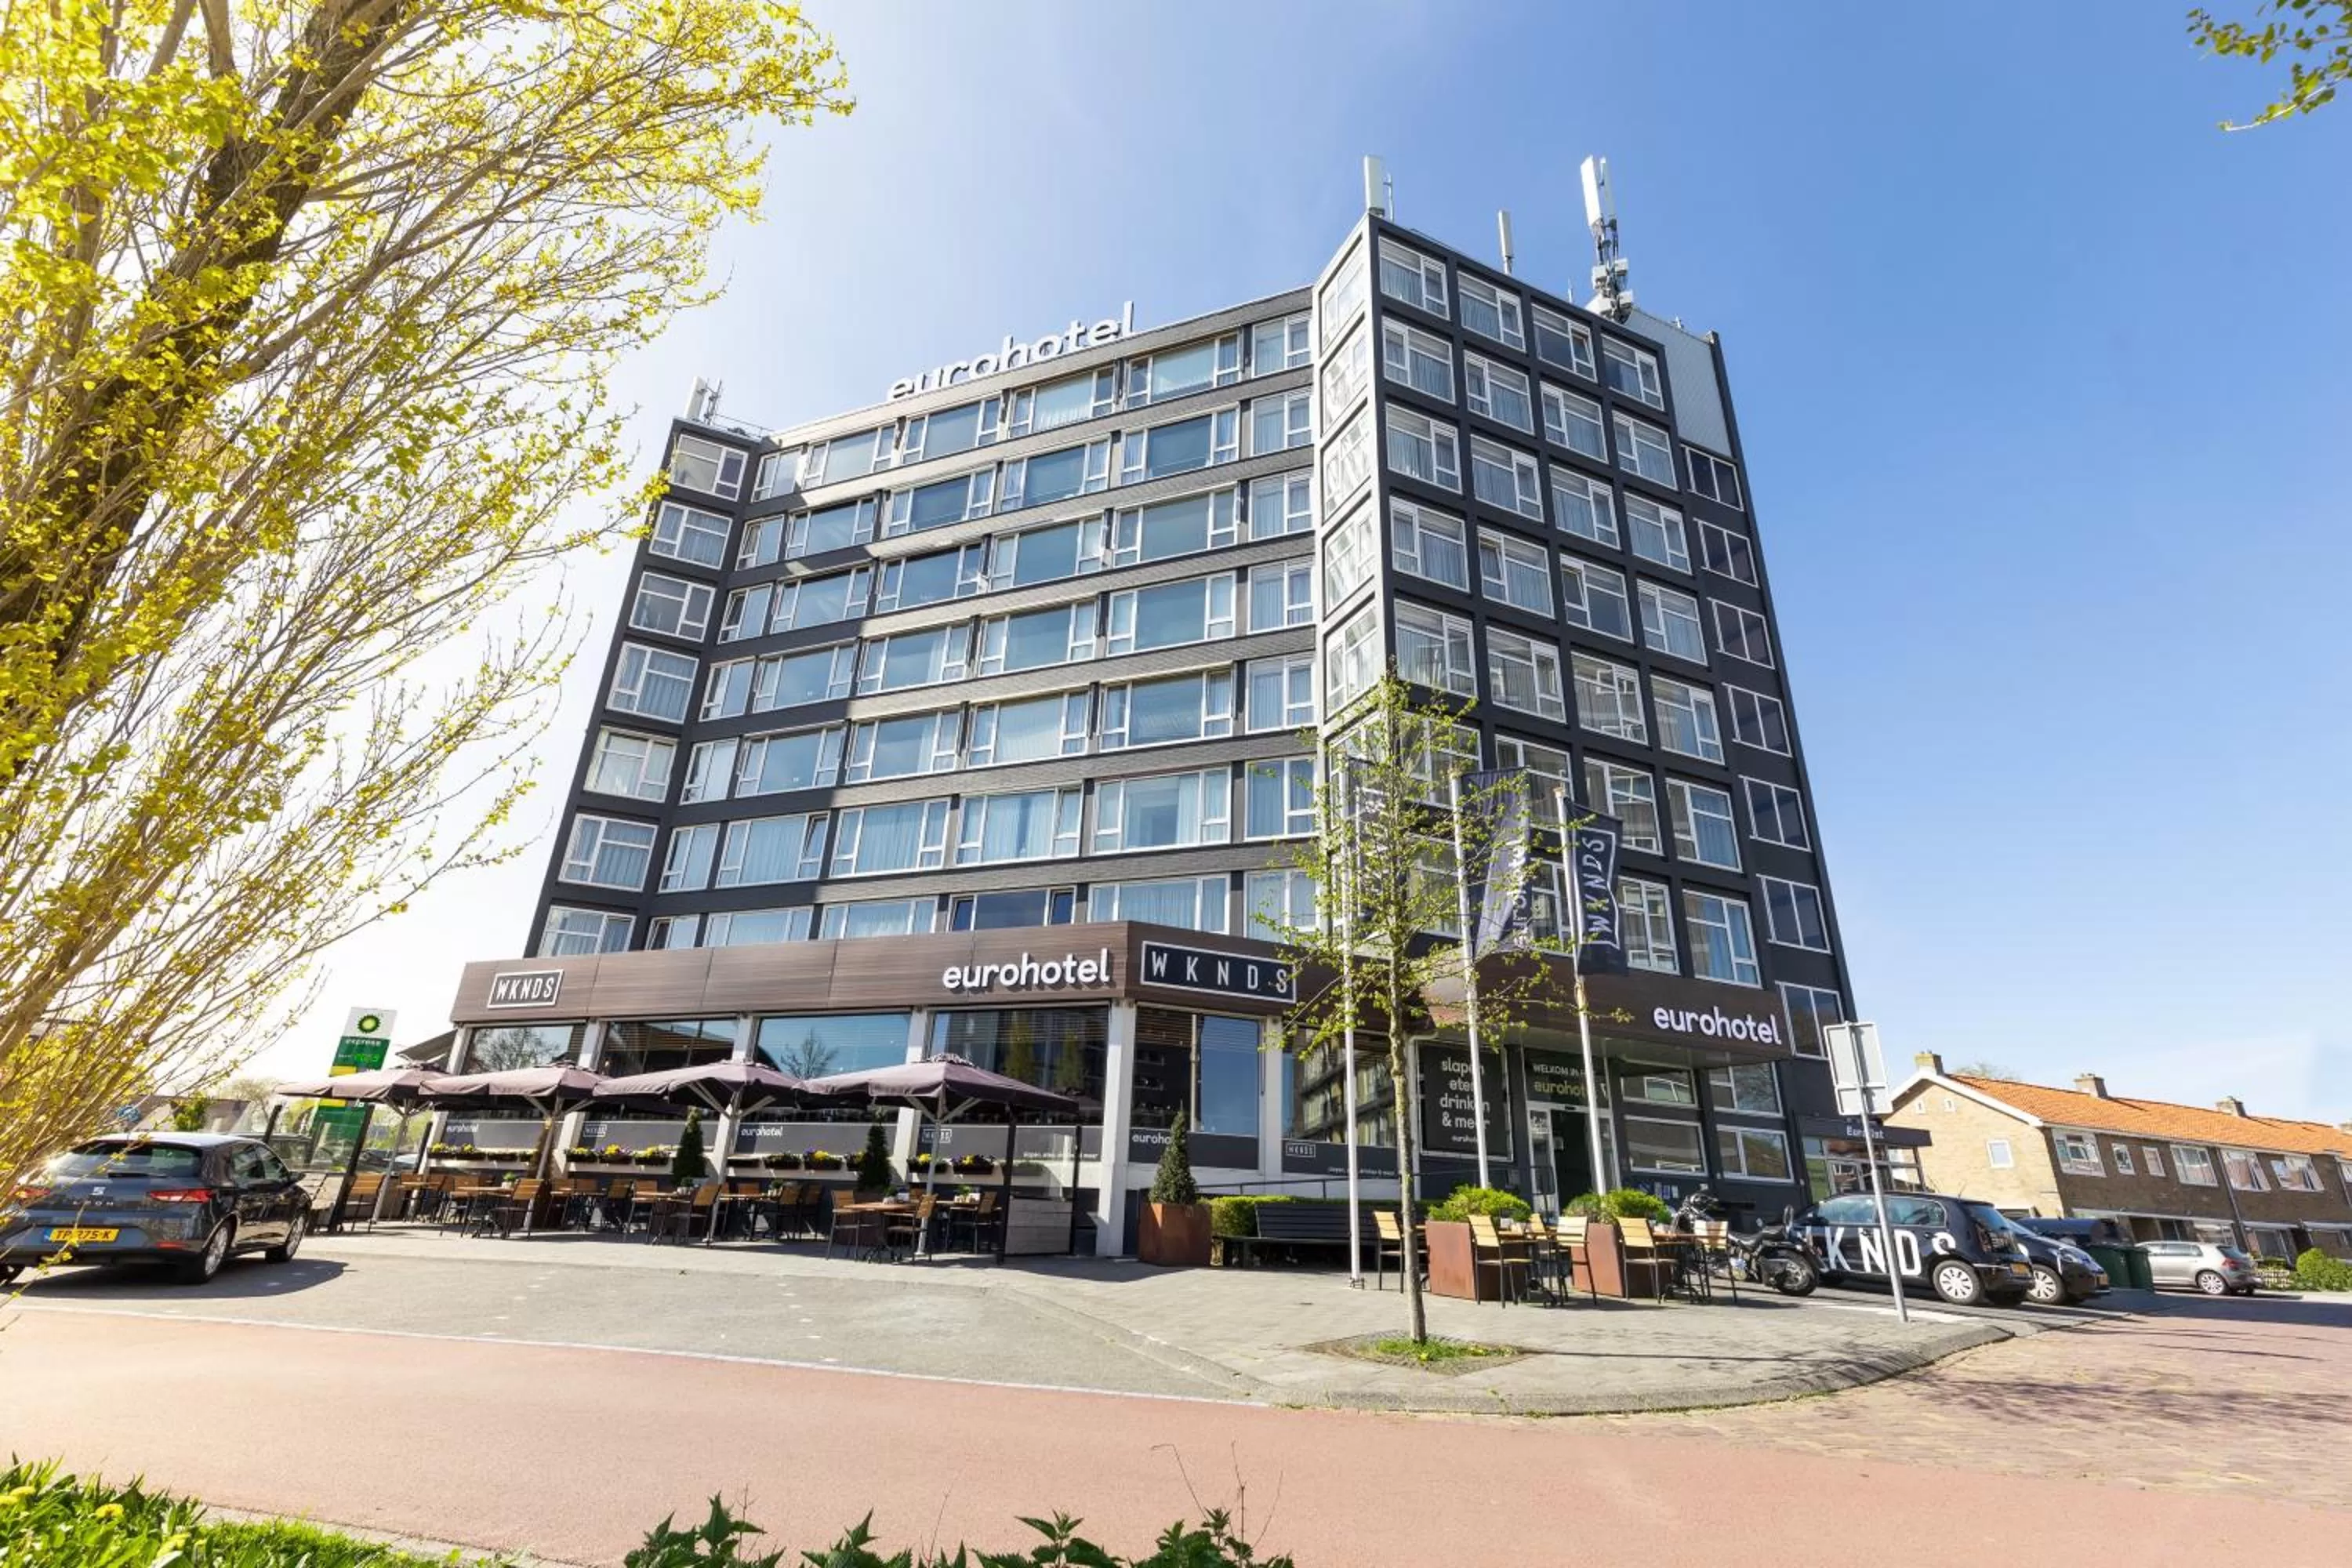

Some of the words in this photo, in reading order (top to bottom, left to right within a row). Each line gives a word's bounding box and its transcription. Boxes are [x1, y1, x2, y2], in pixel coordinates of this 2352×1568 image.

[887, 301, 1134, 401] eurohotel
[942, 947, 1110, 989] eurohotel
[1151, 950, 1287, 994] WKNDS
[495, 977, 555, 1001] WKNDS
[1653, 1005, 1782, 1046] eurohotel
[1439, 1092, 1490, 1112] drinkn
[1443, 1111, 1452, 1127] &
[1454, 1116, 1490, 1129] mer
[1131, 1131, 1172, 1145] euroho
